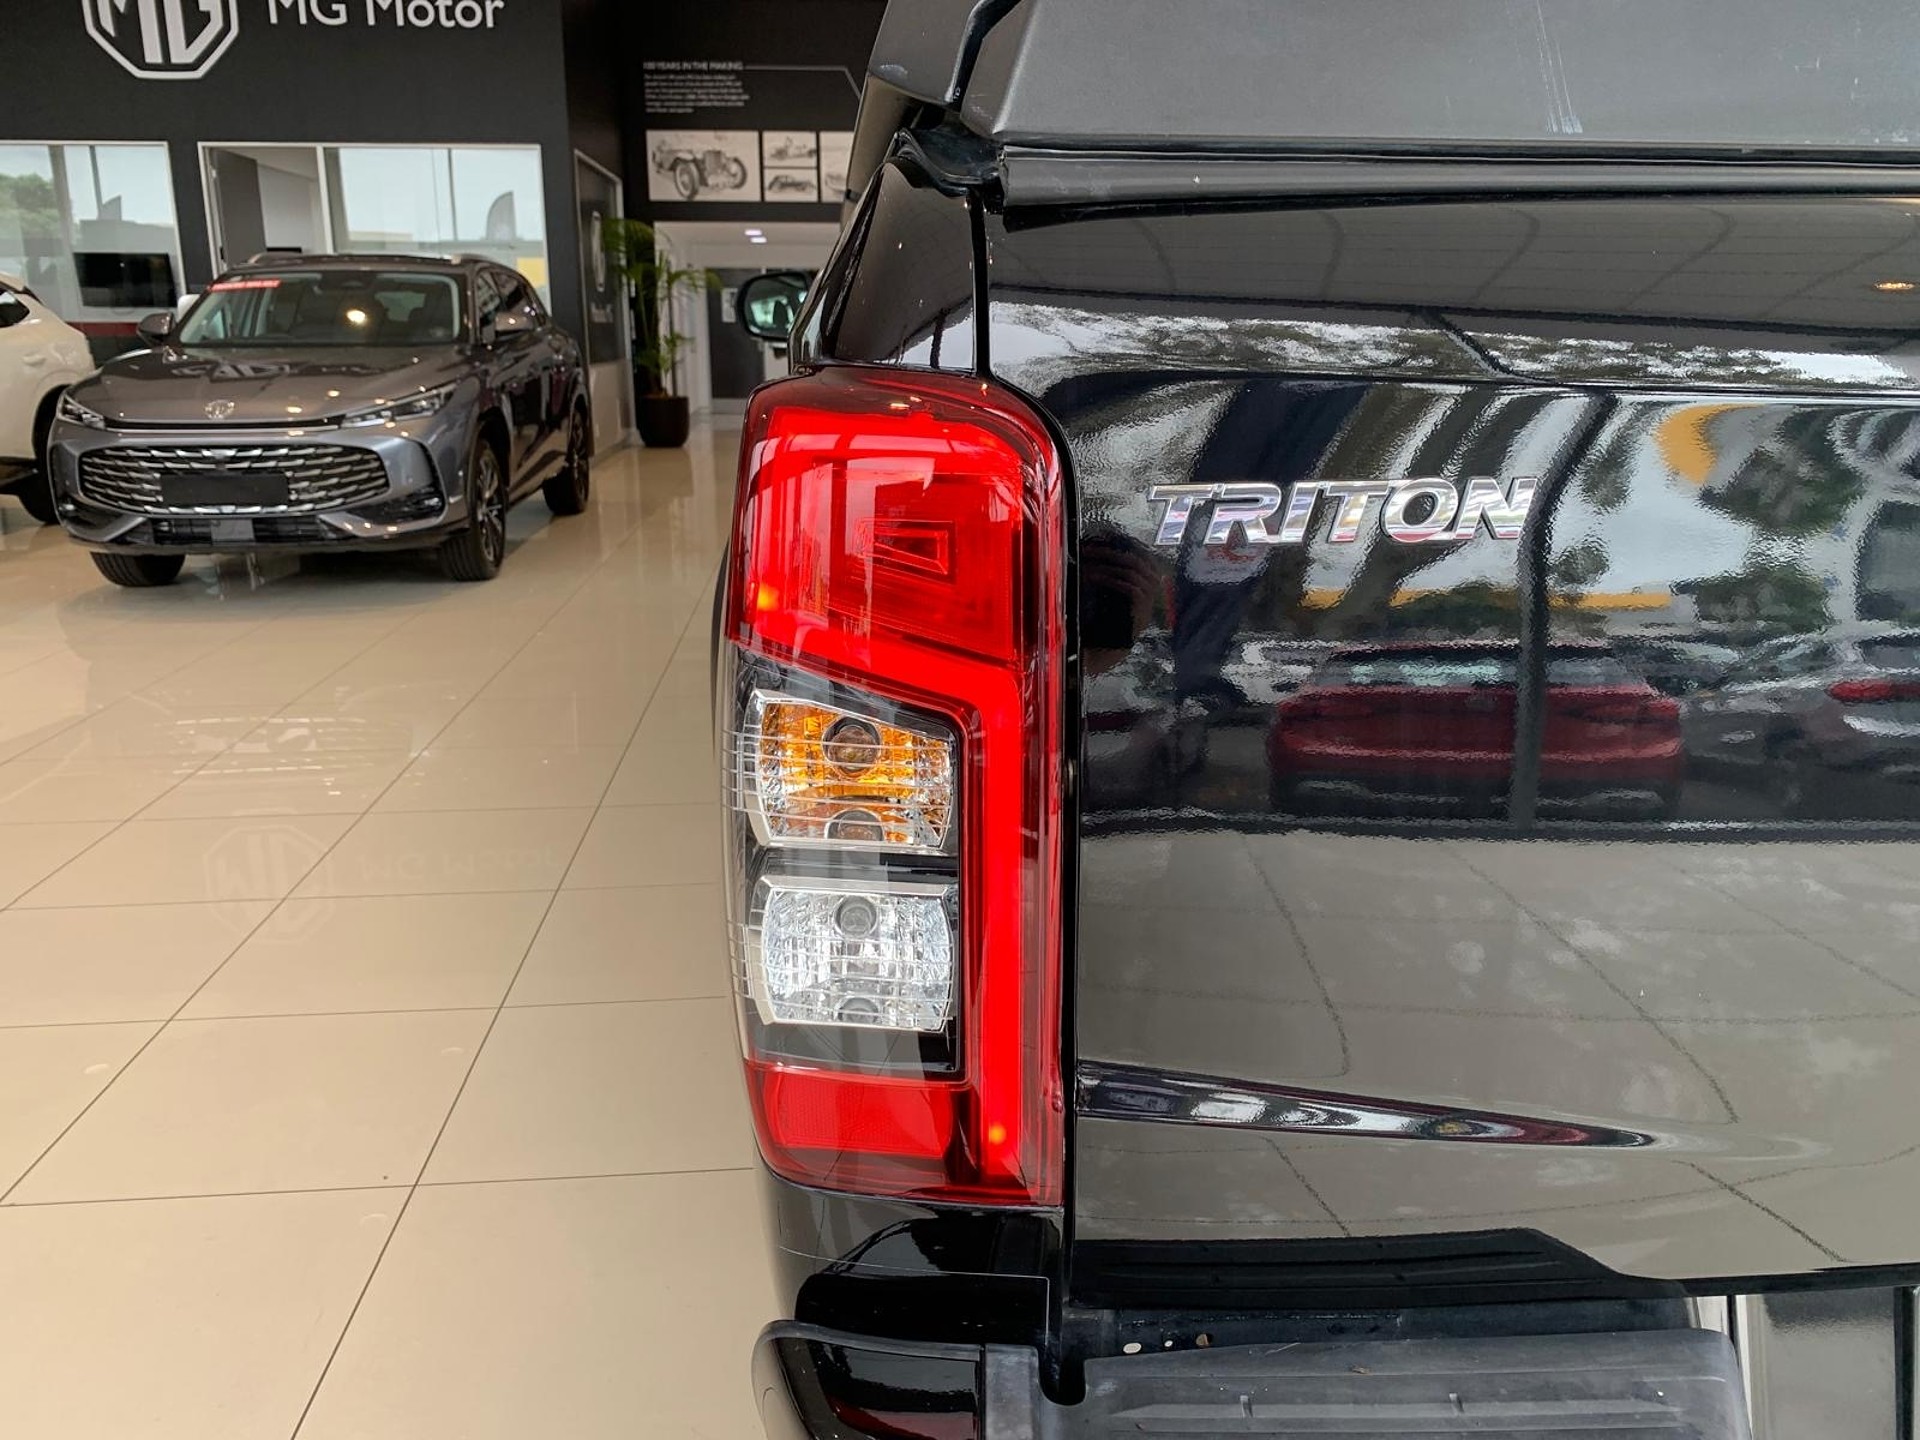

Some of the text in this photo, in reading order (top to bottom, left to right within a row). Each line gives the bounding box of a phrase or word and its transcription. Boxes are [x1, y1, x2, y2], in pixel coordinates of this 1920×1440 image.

[268, 0, 505, 28] MG Motor
[1149, 476, 1538, 546] TRITON
